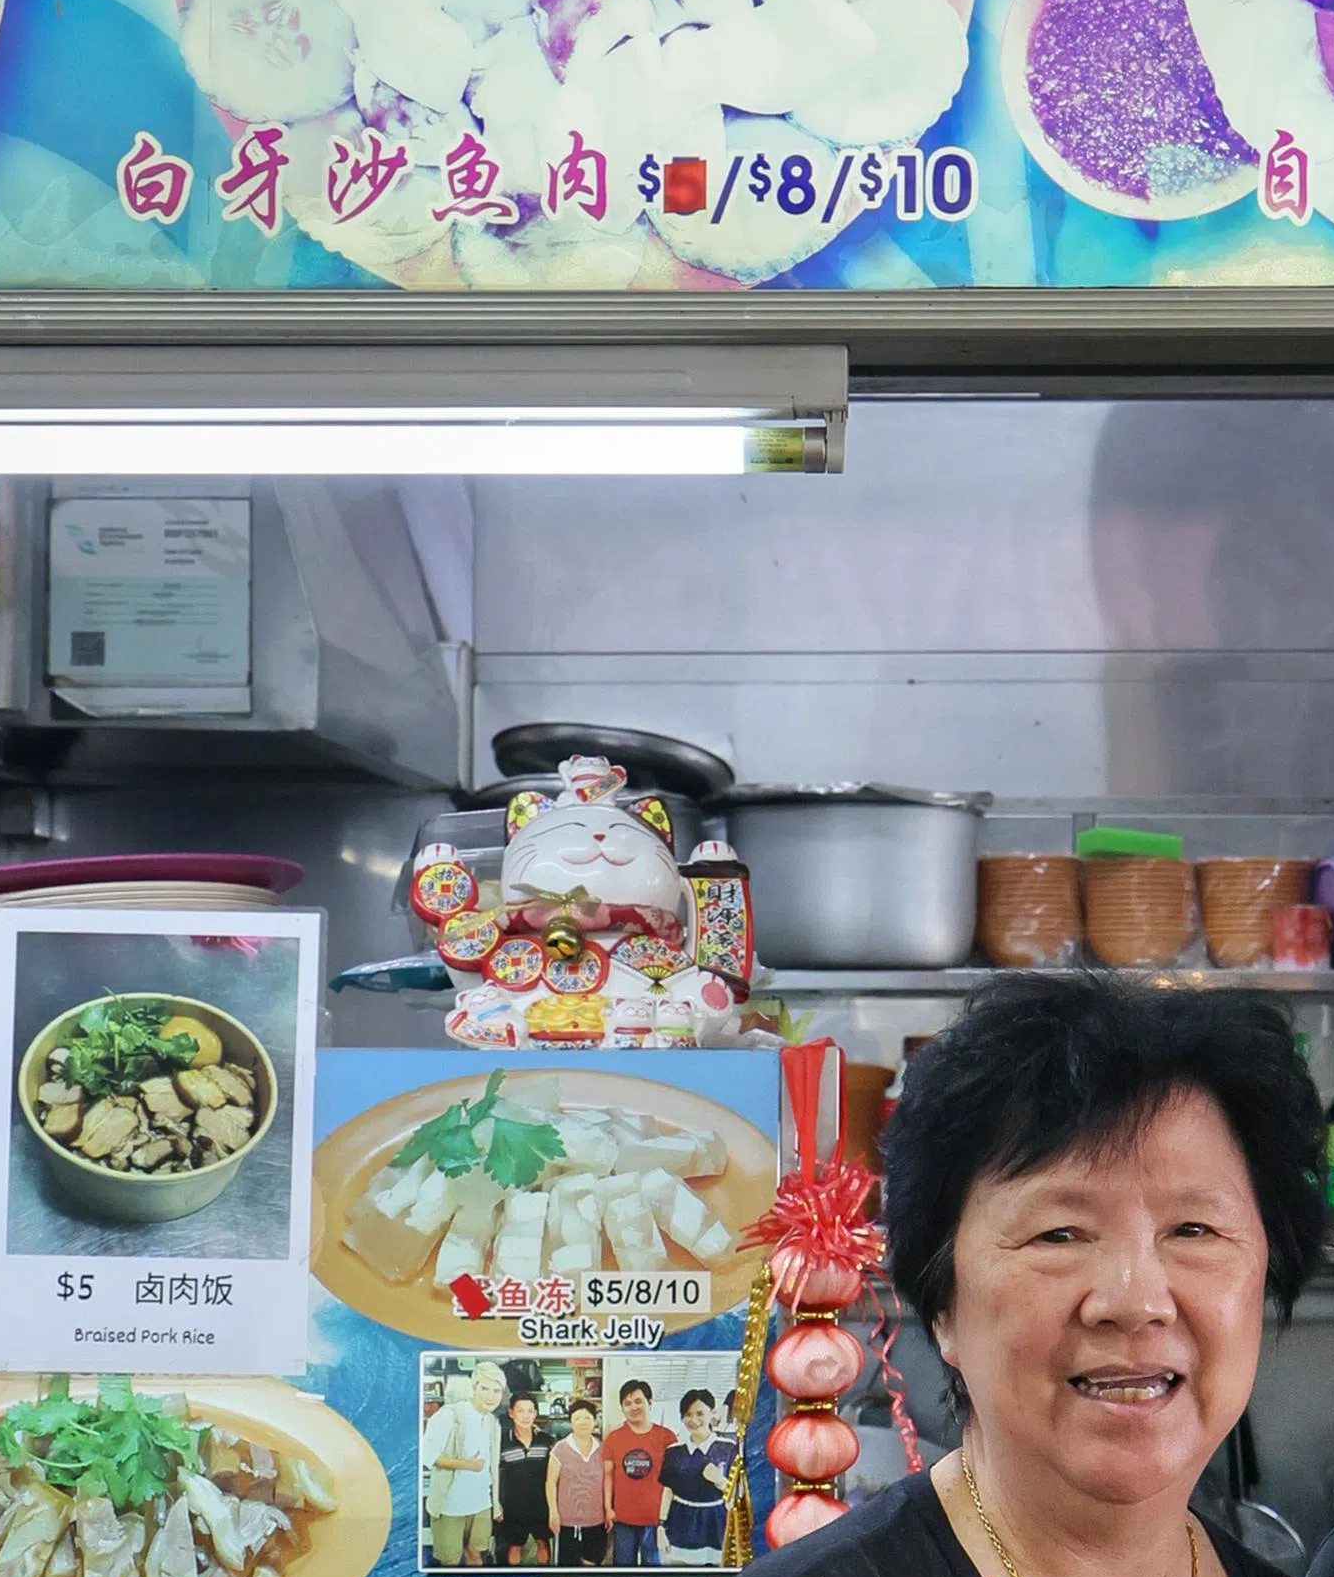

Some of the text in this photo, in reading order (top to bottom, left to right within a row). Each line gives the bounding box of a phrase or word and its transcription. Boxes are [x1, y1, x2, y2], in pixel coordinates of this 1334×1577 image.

[55, 1271, 234, 1308] $5 卤肉饭
[587, 1278, 701, 1306] $5/8/10
[73, 1327, 216, 1345] Braised Pork Rice
[520, 1317, 662, 1345] Shark Jelly
